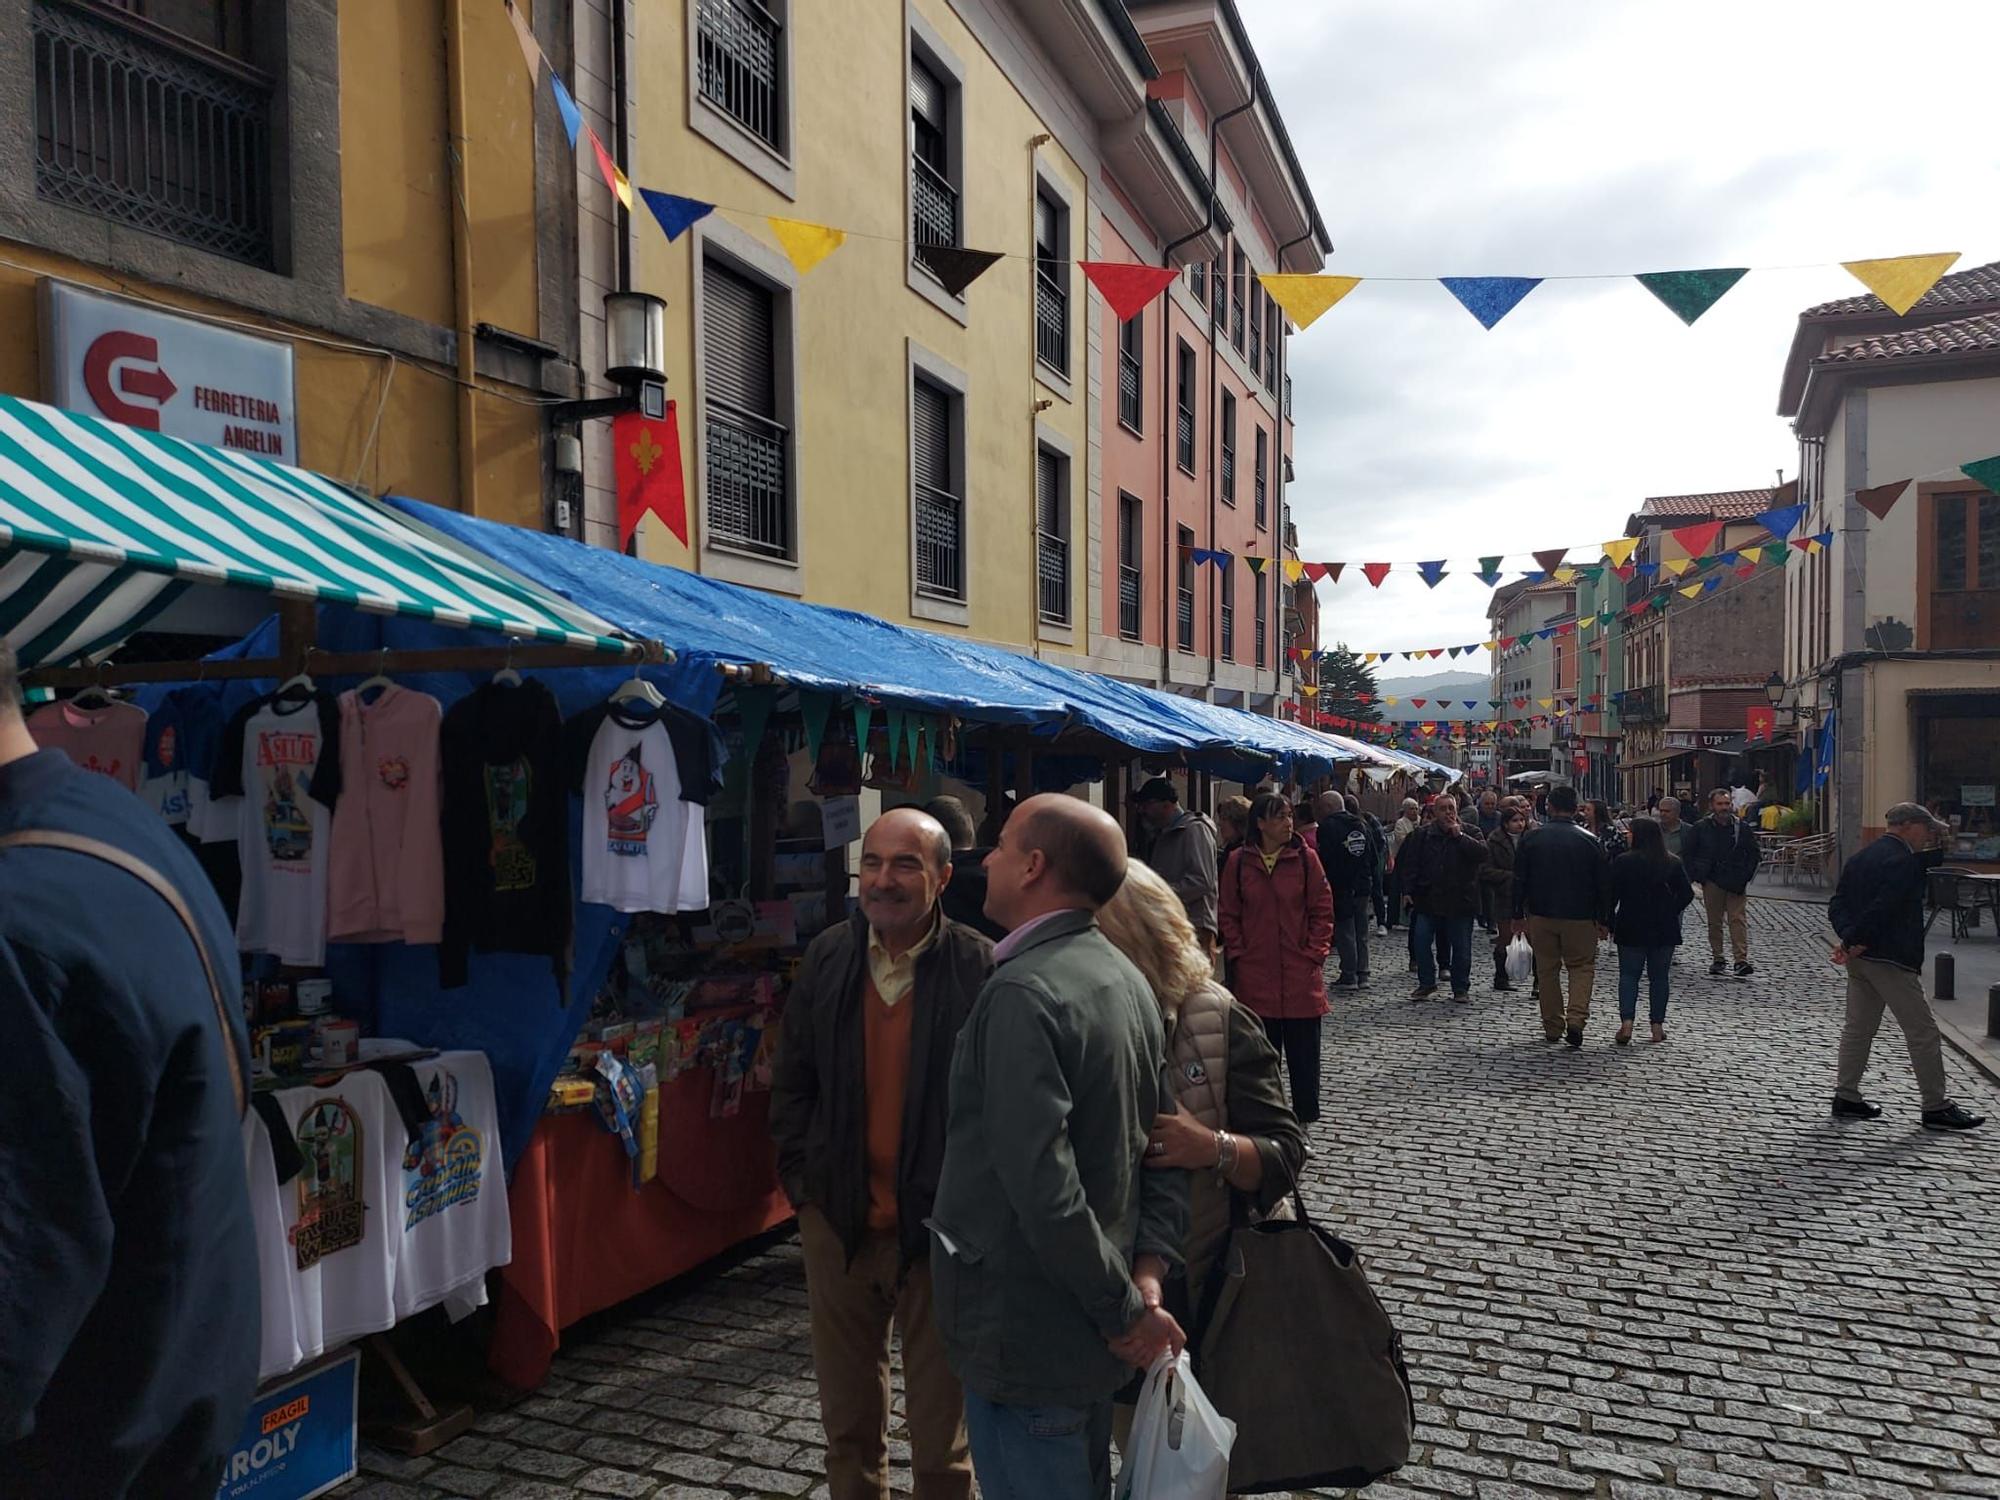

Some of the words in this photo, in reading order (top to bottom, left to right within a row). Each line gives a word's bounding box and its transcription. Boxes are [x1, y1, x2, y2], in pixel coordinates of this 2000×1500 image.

[194, 385, 280, 425] FERRETERIA
[223, 425, 282, 455] ANGELIN
[263, 1401, 307, 1430] FRAGIL
[231, 1421, 302, 1481] ROLY
